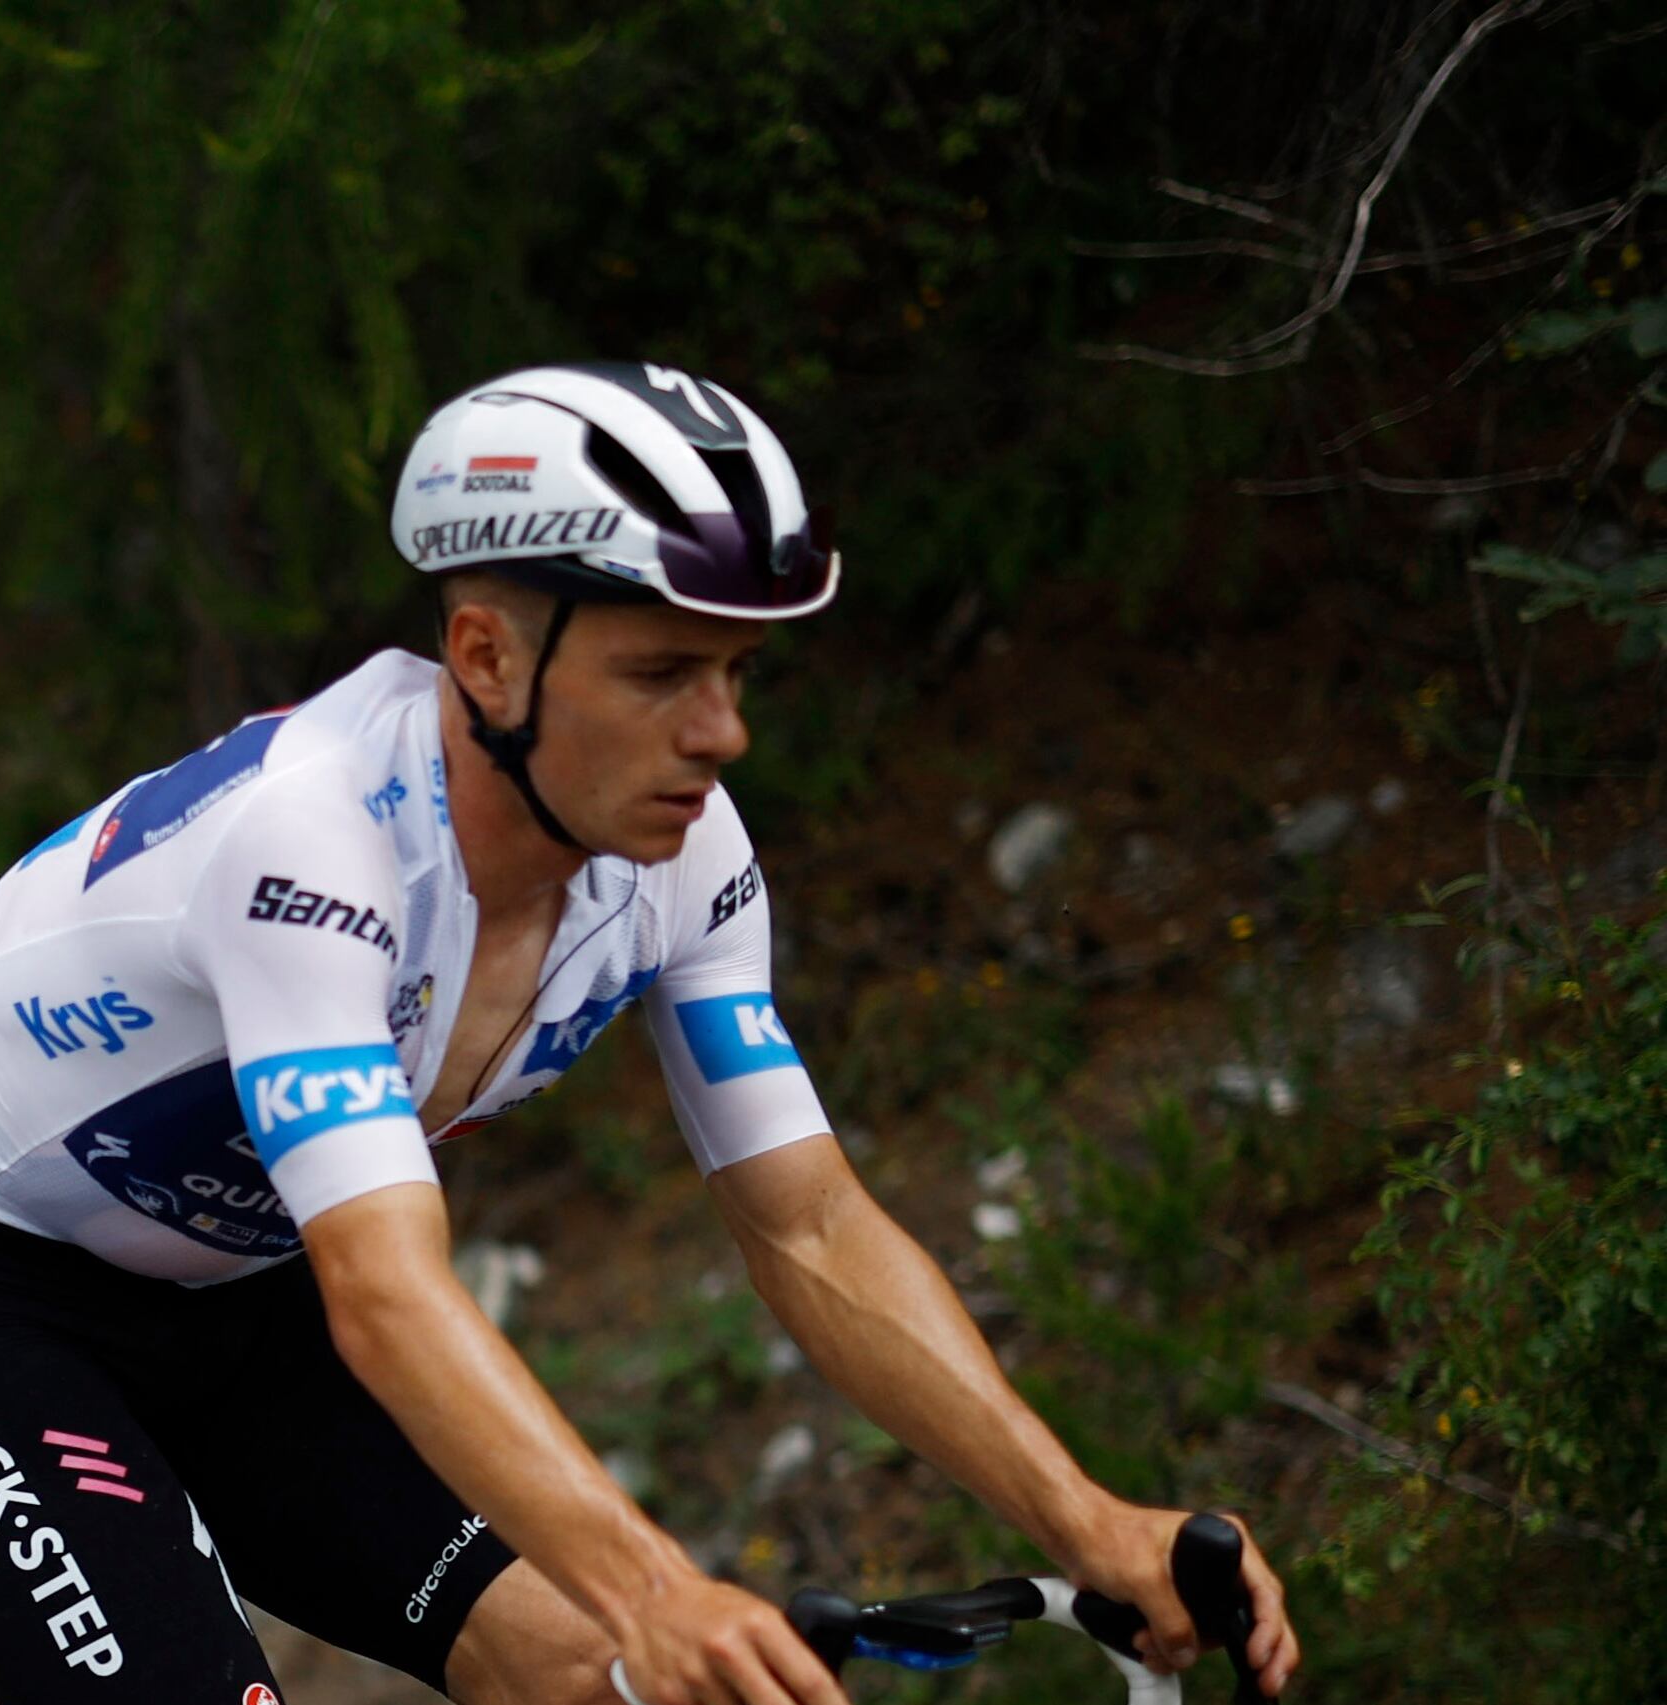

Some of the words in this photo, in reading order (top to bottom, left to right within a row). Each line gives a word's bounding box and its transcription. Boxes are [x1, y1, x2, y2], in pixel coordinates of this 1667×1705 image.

[461, 474, 532, 493] SOUDAL
[413, 507, 625, 564] SPECIALIZED
[246, 874, 397, 966] Santin
[12, 988, 155, 1062] Krys
[254, 1062, 413, 1134] Krys
